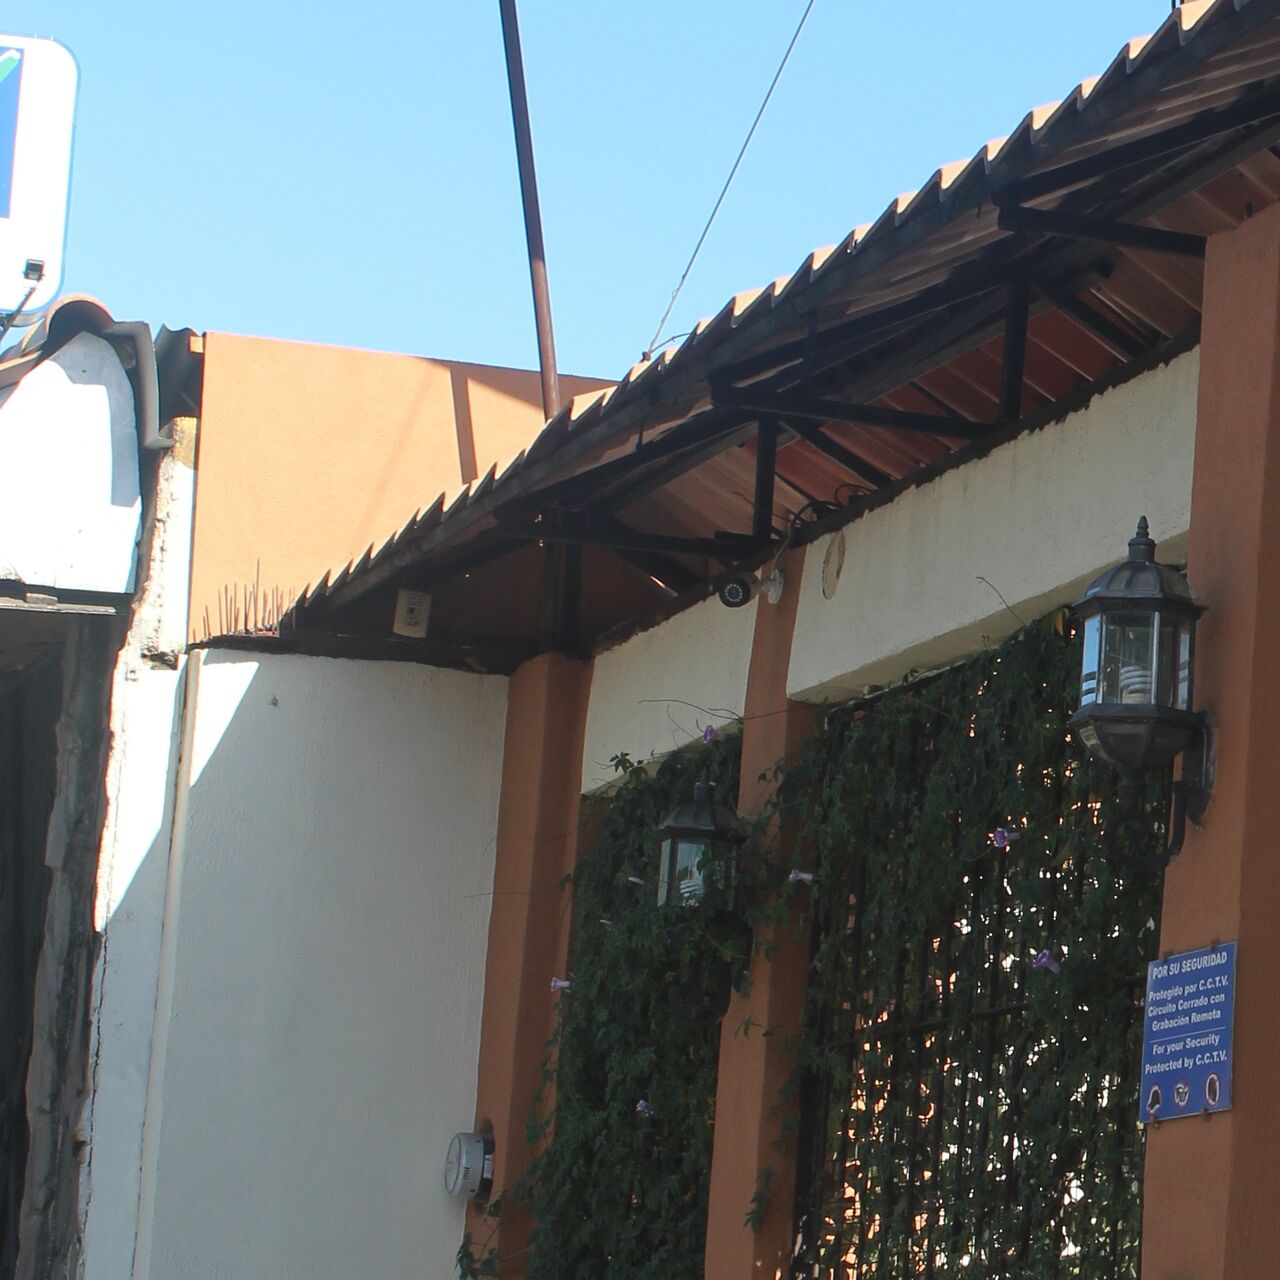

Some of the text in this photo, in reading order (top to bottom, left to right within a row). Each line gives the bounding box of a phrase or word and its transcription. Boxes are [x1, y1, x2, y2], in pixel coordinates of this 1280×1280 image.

[1152, 951, 1228, 980] POR SU SEGURIDAD
[1149, 975, 1229, 1003] Protegido por C.C.T.V.
[1148, 993, 1225, 1016] Circuito Cerrado con
[1152, 1008, 1222, 1032] Grabación Remota
[1153, 1033, 1220, 1055] For your Security
[1145, 1050, 1228, 1075] Protected by C.C.T.V.
